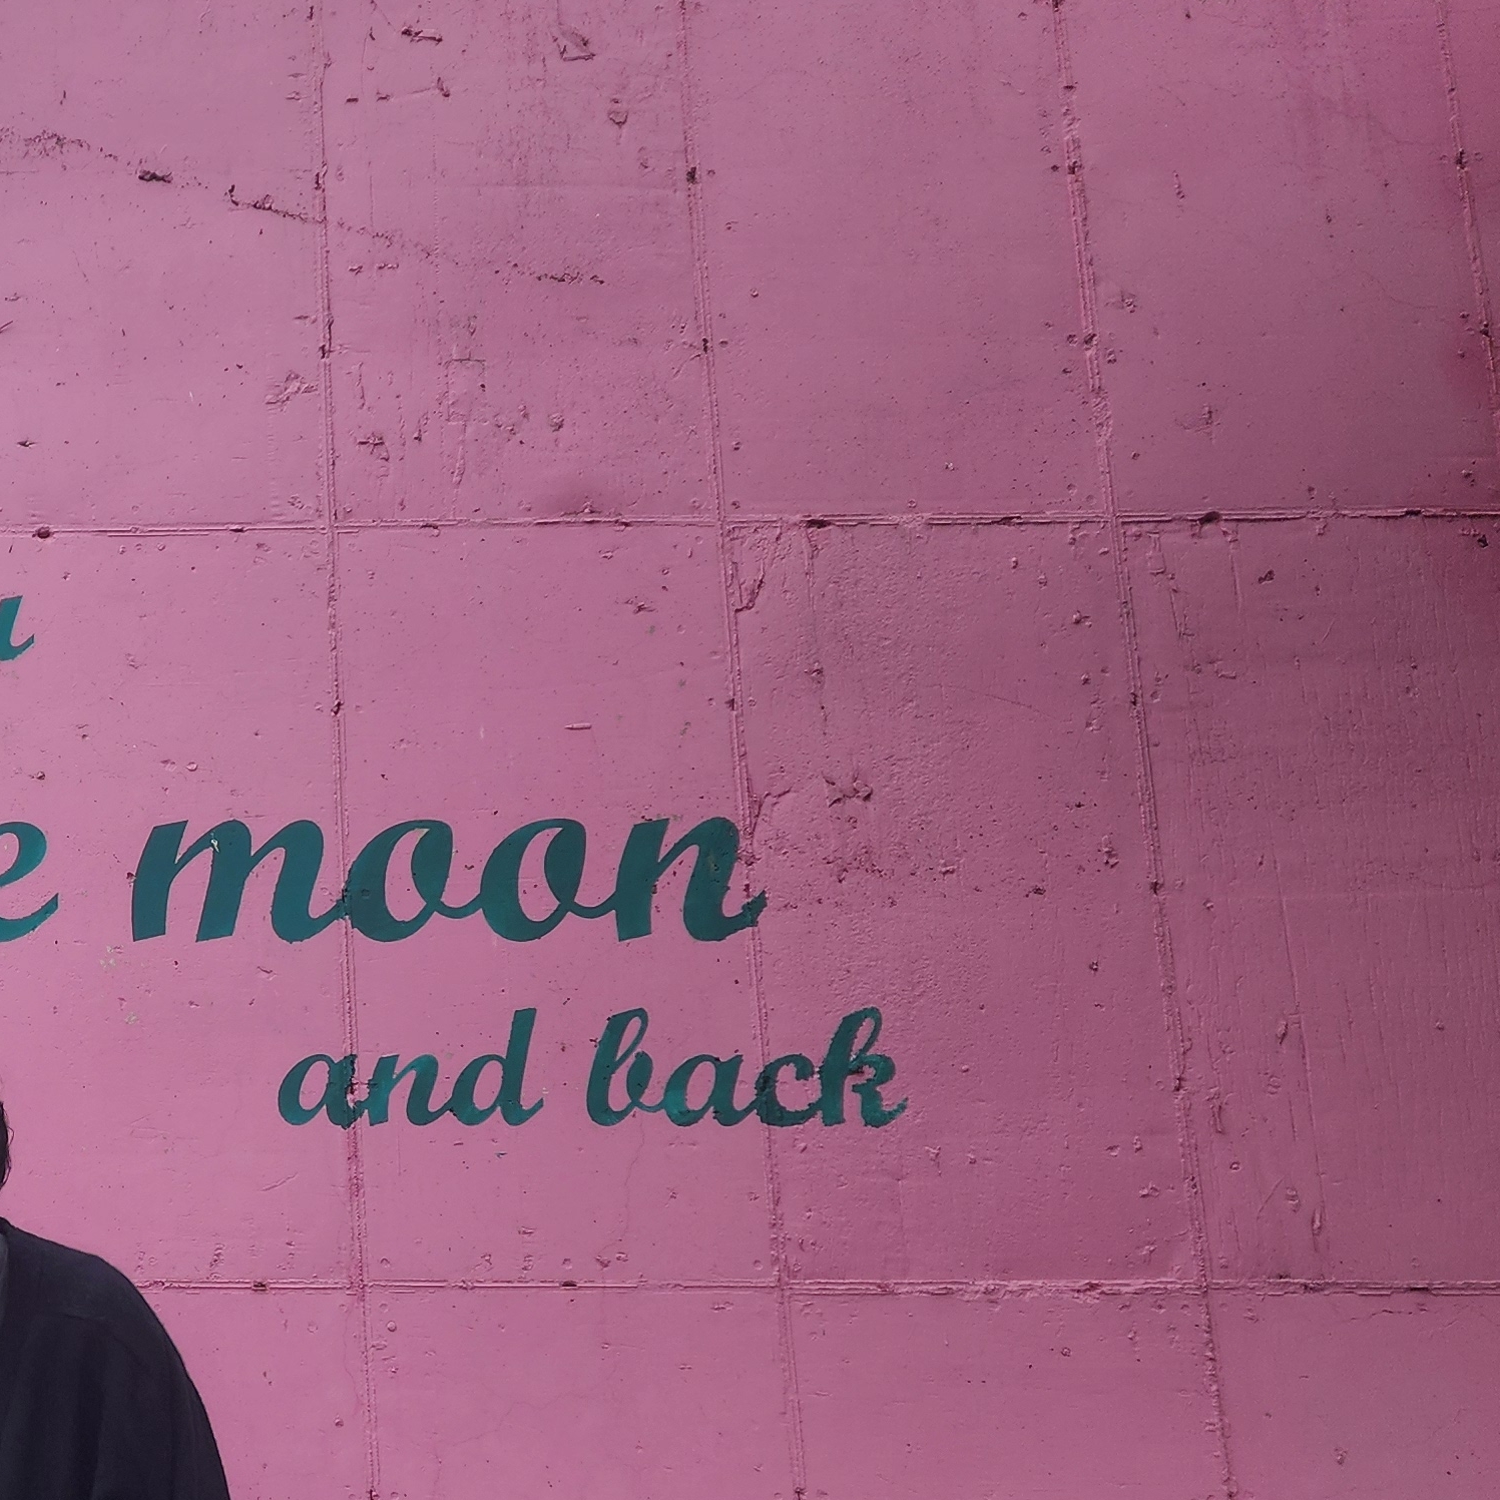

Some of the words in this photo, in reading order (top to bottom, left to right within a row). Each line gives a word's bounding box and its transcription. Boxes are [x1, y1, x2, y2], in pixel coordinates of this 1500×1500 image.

[133, 818, 764, 942] moon
[279, 1008, 543, 1127] and
[587, 1008, 904, 1126] back
